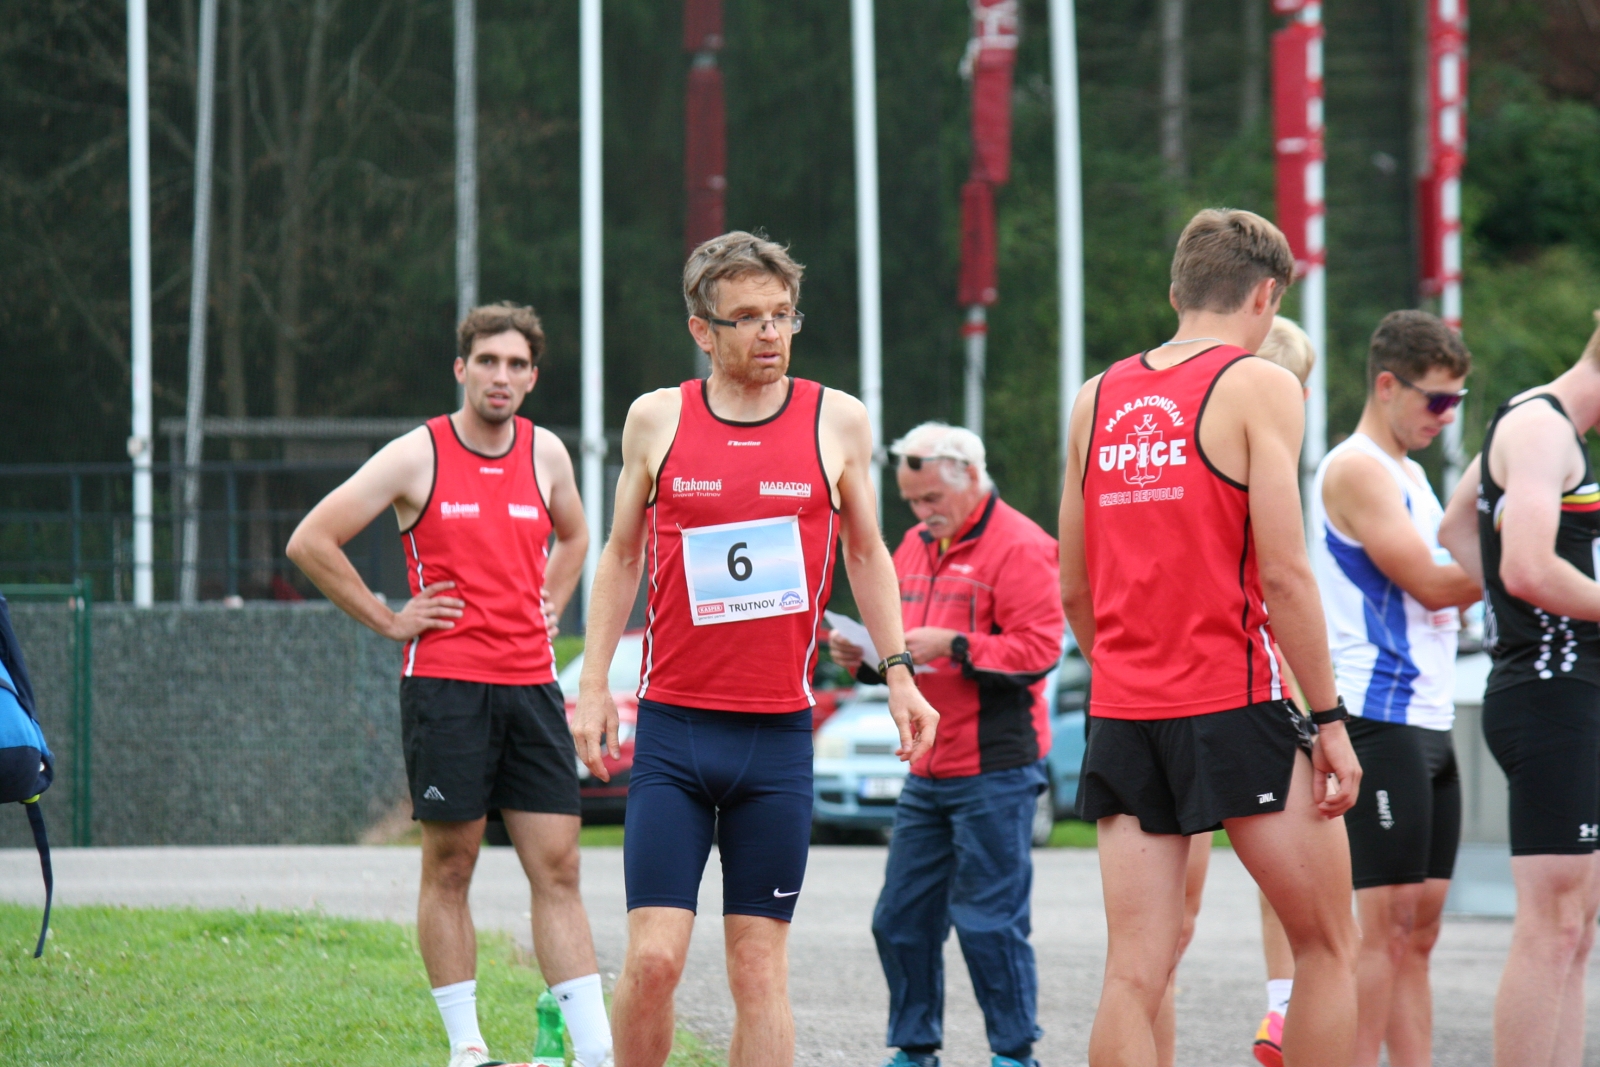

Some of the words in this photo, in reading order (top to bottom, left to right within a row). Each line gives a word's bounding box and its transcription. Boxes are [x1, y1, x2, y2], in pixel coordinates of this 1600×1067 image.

[1105, 395, 1185, 432] MARATONSTAV
[760, 481, 811, 491] MARATON
[1099, 491, 1132, 507] CZECH
[1133, 486, 1184, 503] REPUBLIC
[727, 542, 753, 582] 6
[729, 599, 775, 612] TRUTNOV
